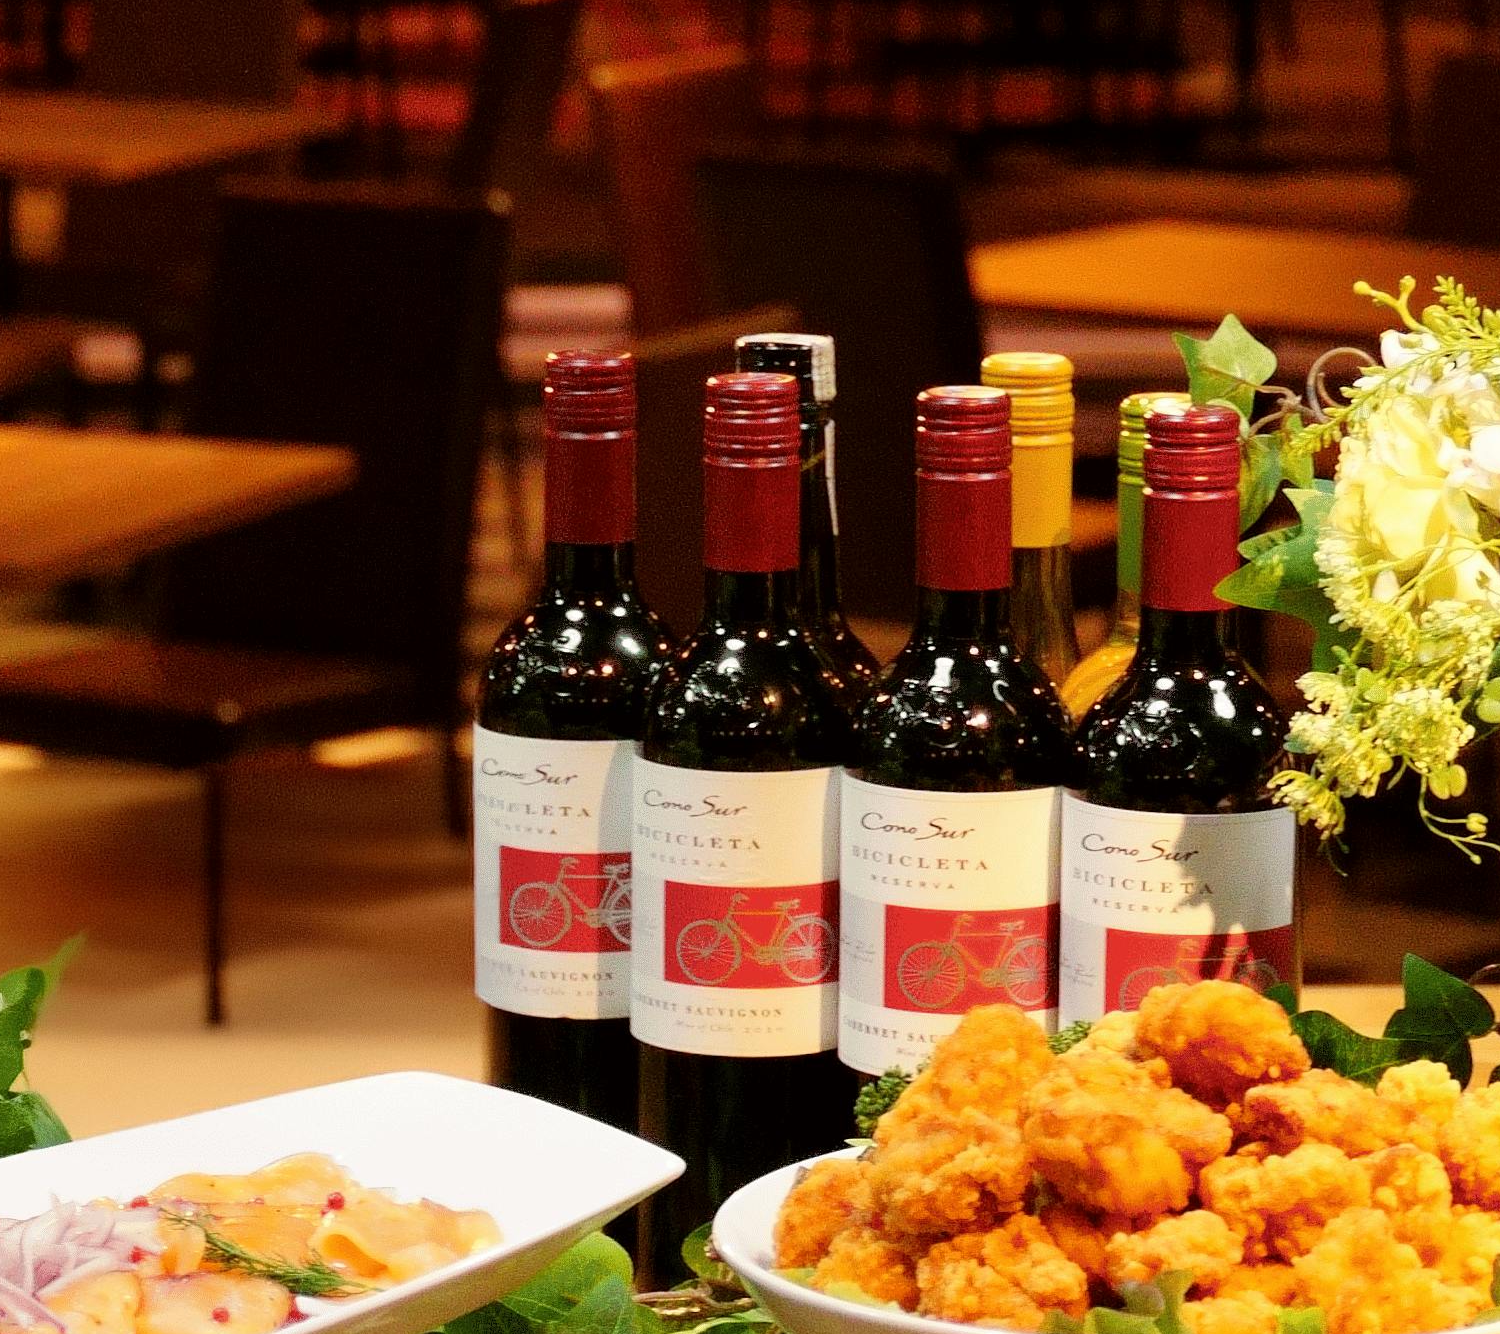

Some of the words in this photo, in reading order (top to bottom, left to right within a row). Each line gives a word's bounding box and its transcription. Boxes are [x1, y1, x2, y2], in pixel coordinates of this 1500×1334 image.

[518, 764, 578, 786] Sur
[643, 789, 692, 812] Cono
[690, 795, 748, 818] Sur
[860, 812, 917, 835] Cono
[914, 817, 976, 840] Sur
[851, 844, 989, 871] BICICLETA
[1081, 833, 1140, 857] Cono
[1136, 839, 1199, 863] Sur
[1072, 867, 1214, 895] BICICLETA
[685, 1004, 784, 1019] SAUVIGNON
